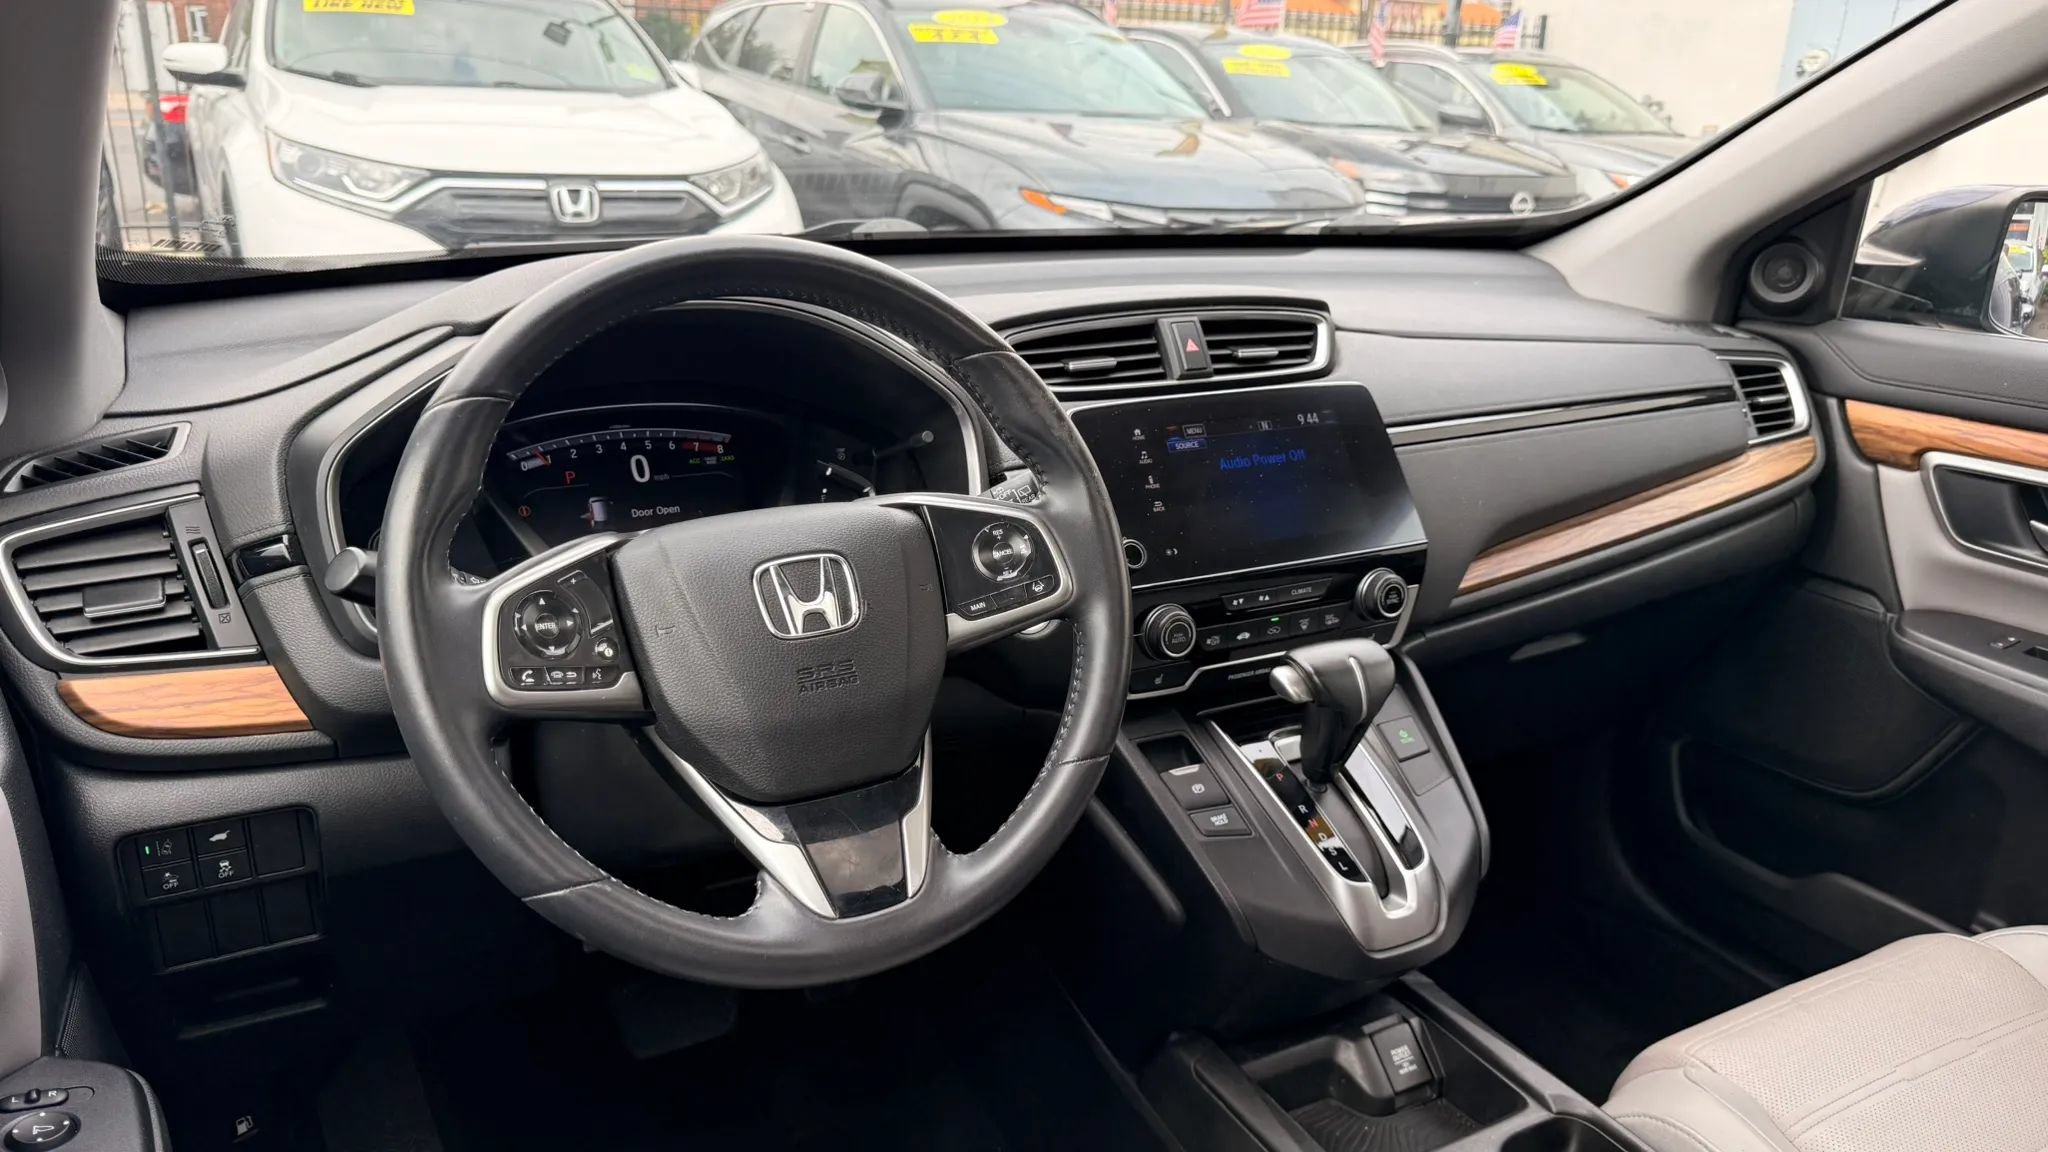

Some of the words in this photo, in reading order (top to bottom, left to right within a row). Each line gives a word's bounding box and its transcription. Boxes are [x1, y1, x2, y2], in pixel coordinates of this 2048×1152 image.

[571, 449, 578, 459] 2
[596, 444, 603, 454] 3
[620, 441, 627, 451] 4
[645, 440, 652, 450] 5
[669, 440, 676, 450] 6
[693, 442, 699, 452] 7
[717, 444, 724, 454] 8
[1175, 441, 1200, 450] SOURCE
[1220, 456, 1251, 471] Audio
[1252, 453, 1287, 467] Power
[1289, 449, 1306, 460] Off
[630, 454, 651, 483] 0
[565, 471, 576, 484] P
[631, 506, 654, 518] Door
[656, 504, 681, 517] Open
[1291, 586, 1312, 596] CLIMATE
[970, 602, 986, 611] MAIN
[535, 622, 556, 632] ENTER
[797, 659, 857, 681] SRS
[799, 675, 860, 695] AIRBAG
[1298, 804, 1309, 815] R
[1318, 832, 1328, 841] D
[1328, 847, 1338, 856] S
[1338, 861, 1349, 872] L
[218, 870, 234, 879] OFF
[163, 881, 179, 890] OFF
[48, 1090, 57, 1098] R
